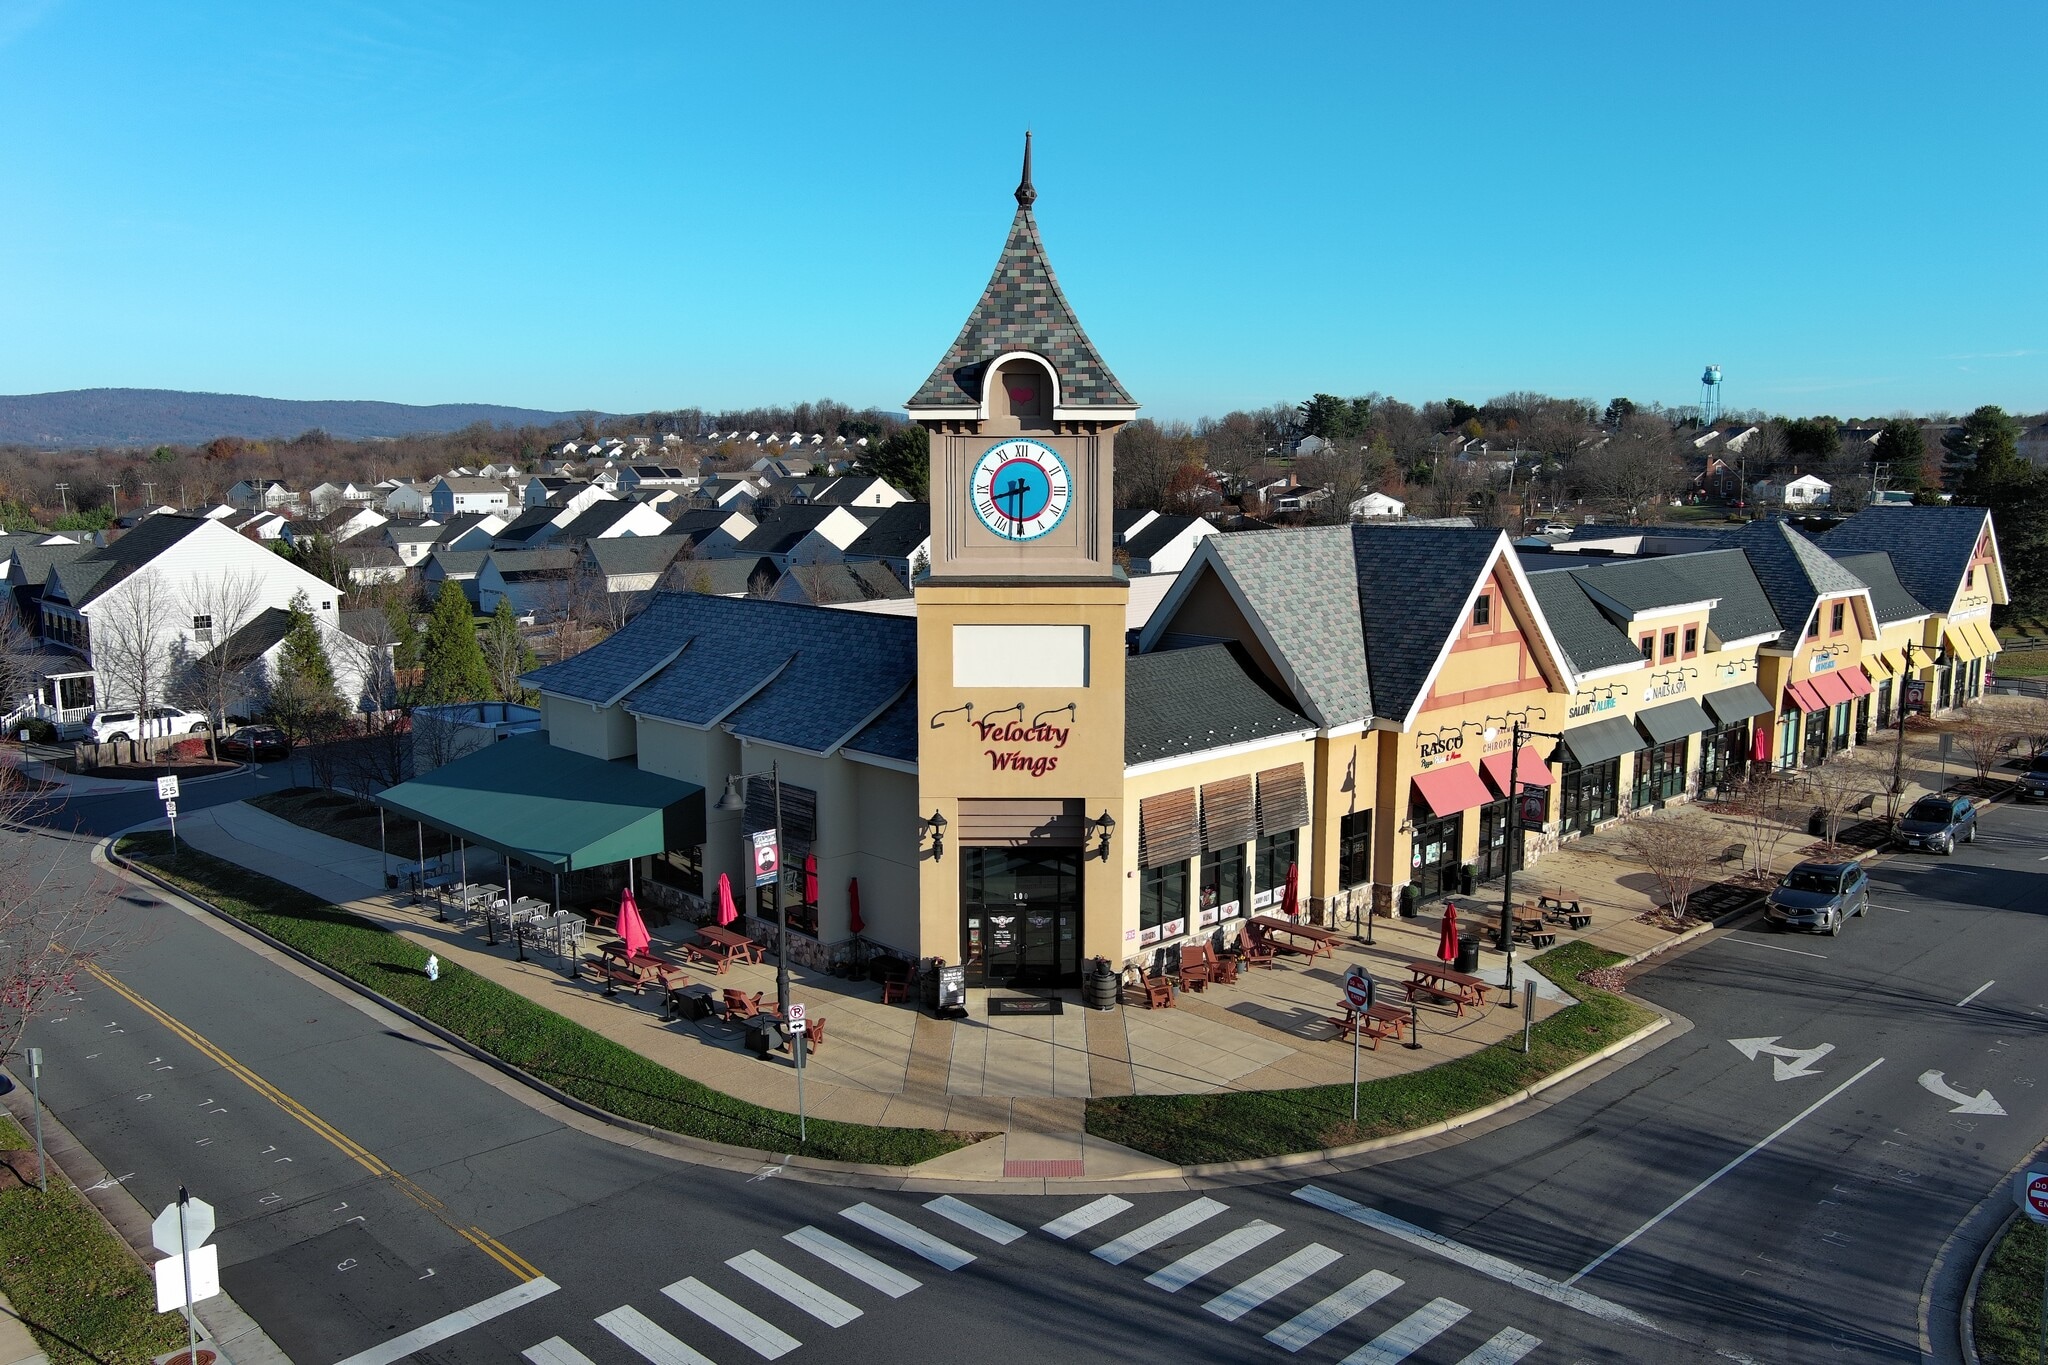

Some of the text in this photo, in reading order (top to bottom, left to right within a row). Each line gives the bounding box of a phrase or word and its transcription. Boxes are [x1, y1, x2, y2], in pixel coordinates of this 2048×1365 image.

[996, 449, 1008, 463] XI
[1015, 444, 1028, 457] XII
[982, 465, 994, 475] X
[1048, 466, 1062, 476] II
[977, 484, 989, 494] IX
[1054, 486, 1066, 496] III
[979, 500, 994, 519] VIII
[1049, 504, 1062, 517] IV
[994, 516, 1008, 532] VII
[1037, 520, 1045, 530] V
[1652, 684, 1670, 700] NAILS
[1676, 680, 1687, 693] SPA
[1569, 704, 1590, 718] SALON
[971, 720, 1070, 749] Velocity
[1420, 735, 1464, 758] RASCO
[984, 749, 1058, 777] Wings
[161, 786, 176, 796] 25
